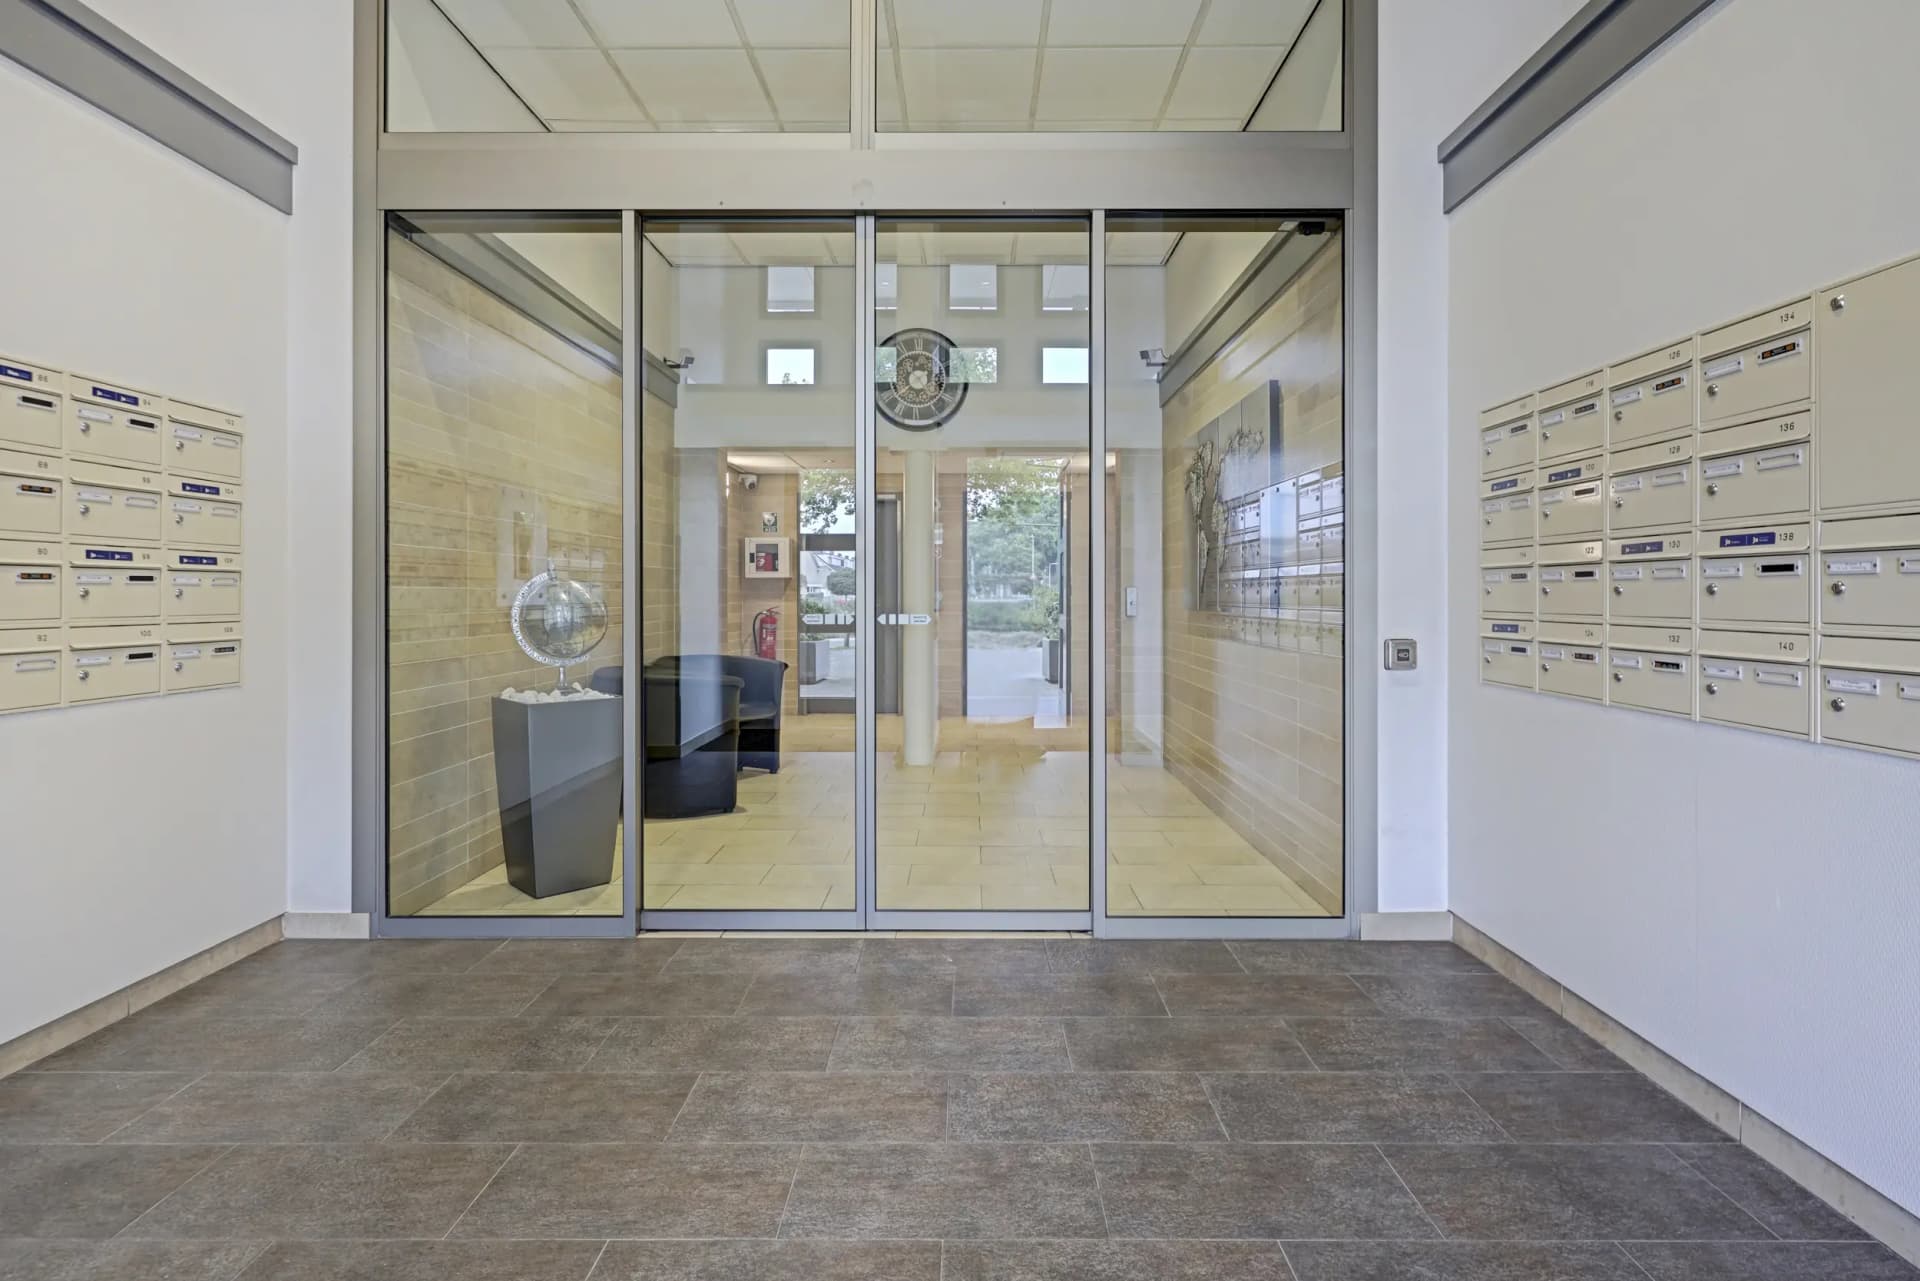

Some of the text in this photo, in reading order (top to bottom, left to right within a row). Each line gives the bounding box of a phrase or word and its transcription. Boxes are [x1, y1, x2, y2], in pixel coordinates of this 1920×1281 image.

[1780, 312, 1795, 324] 134
[1668, 350, 1681, 361] 126
[1779, 422, 1795, 433] 136
[1669, 445, 1681, 455] 128
[1779, 532, 1794, 542] 138
[1668, 539, 1681, 549] 130
[1585, 546, 1595, 556] 122
[1668, 634, 1680, 643] 132
[1778, 641, 1794, 652] 140
